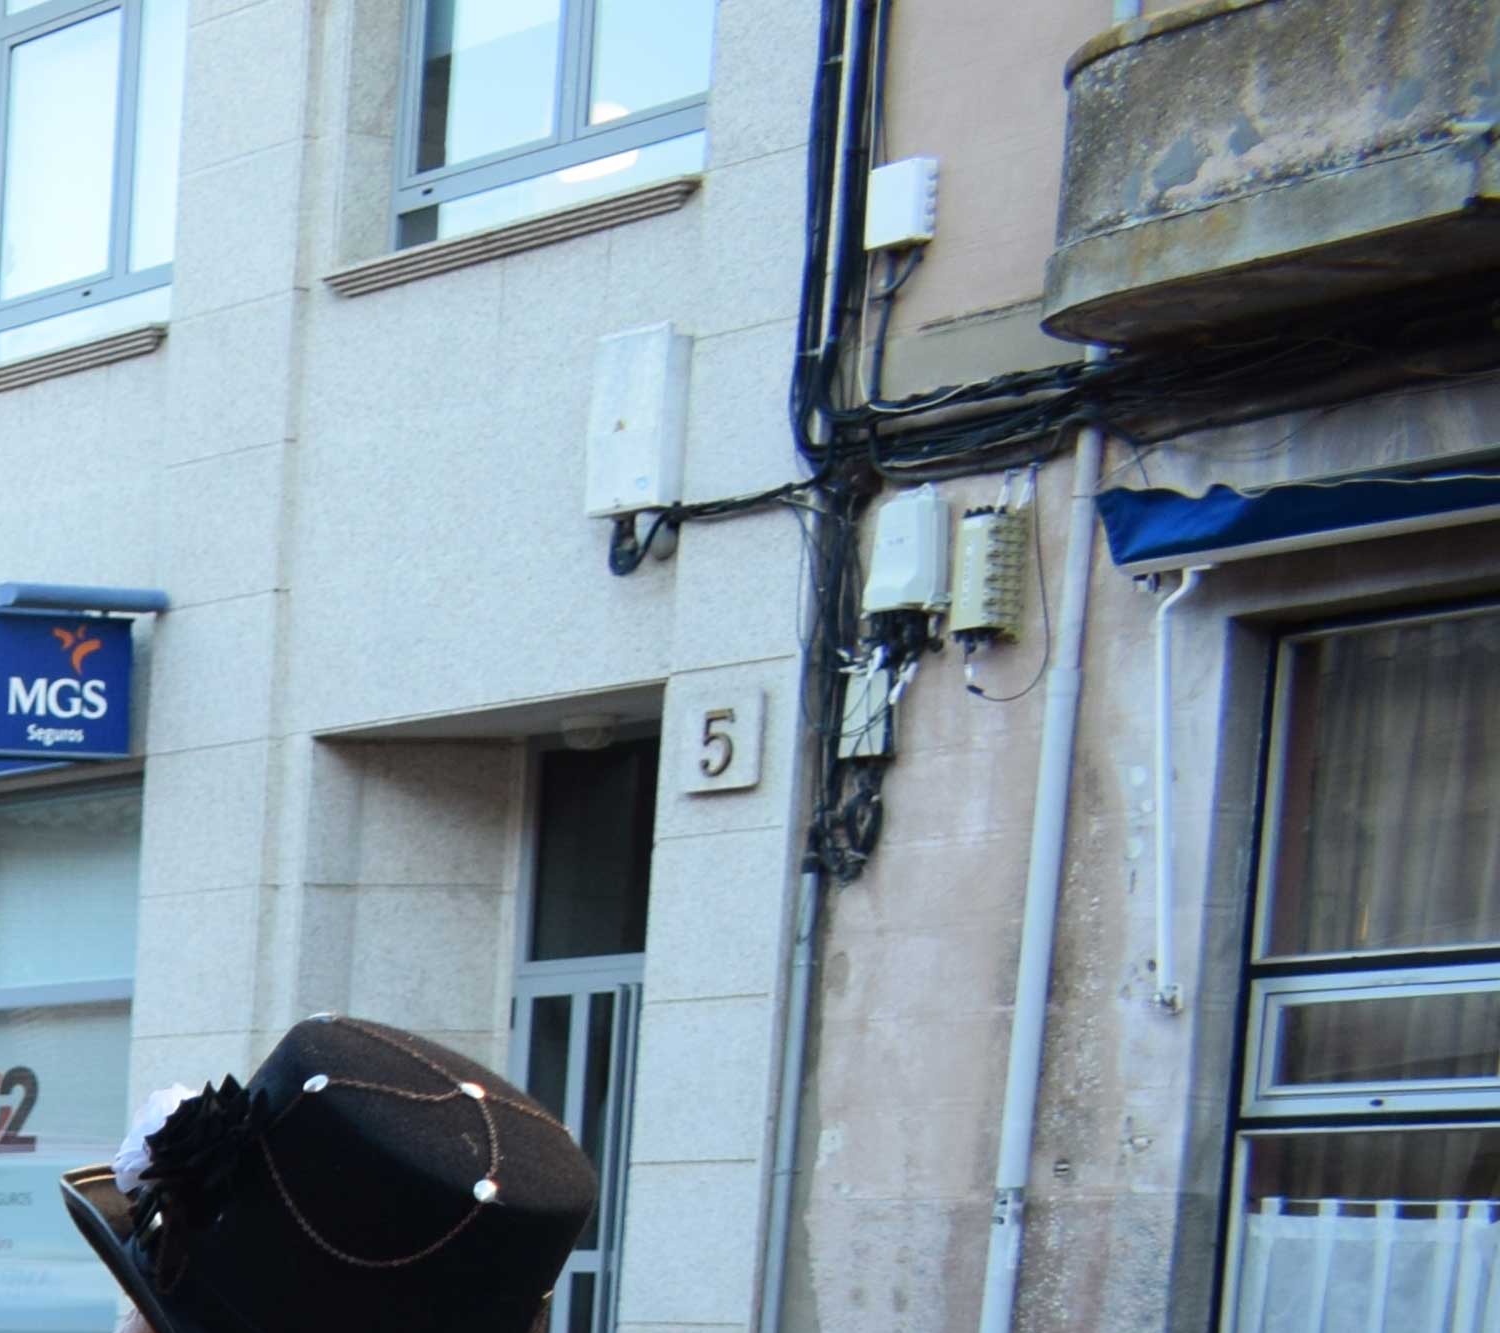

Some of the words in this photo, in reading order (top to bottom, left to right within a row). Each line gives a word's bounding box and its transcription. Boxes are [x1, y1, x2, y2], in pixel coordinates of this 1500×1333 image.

[7, 676, 108, 719] MGS
[26, 723, 85, 745] Seguros
[700, 708, 735, 778] 5
